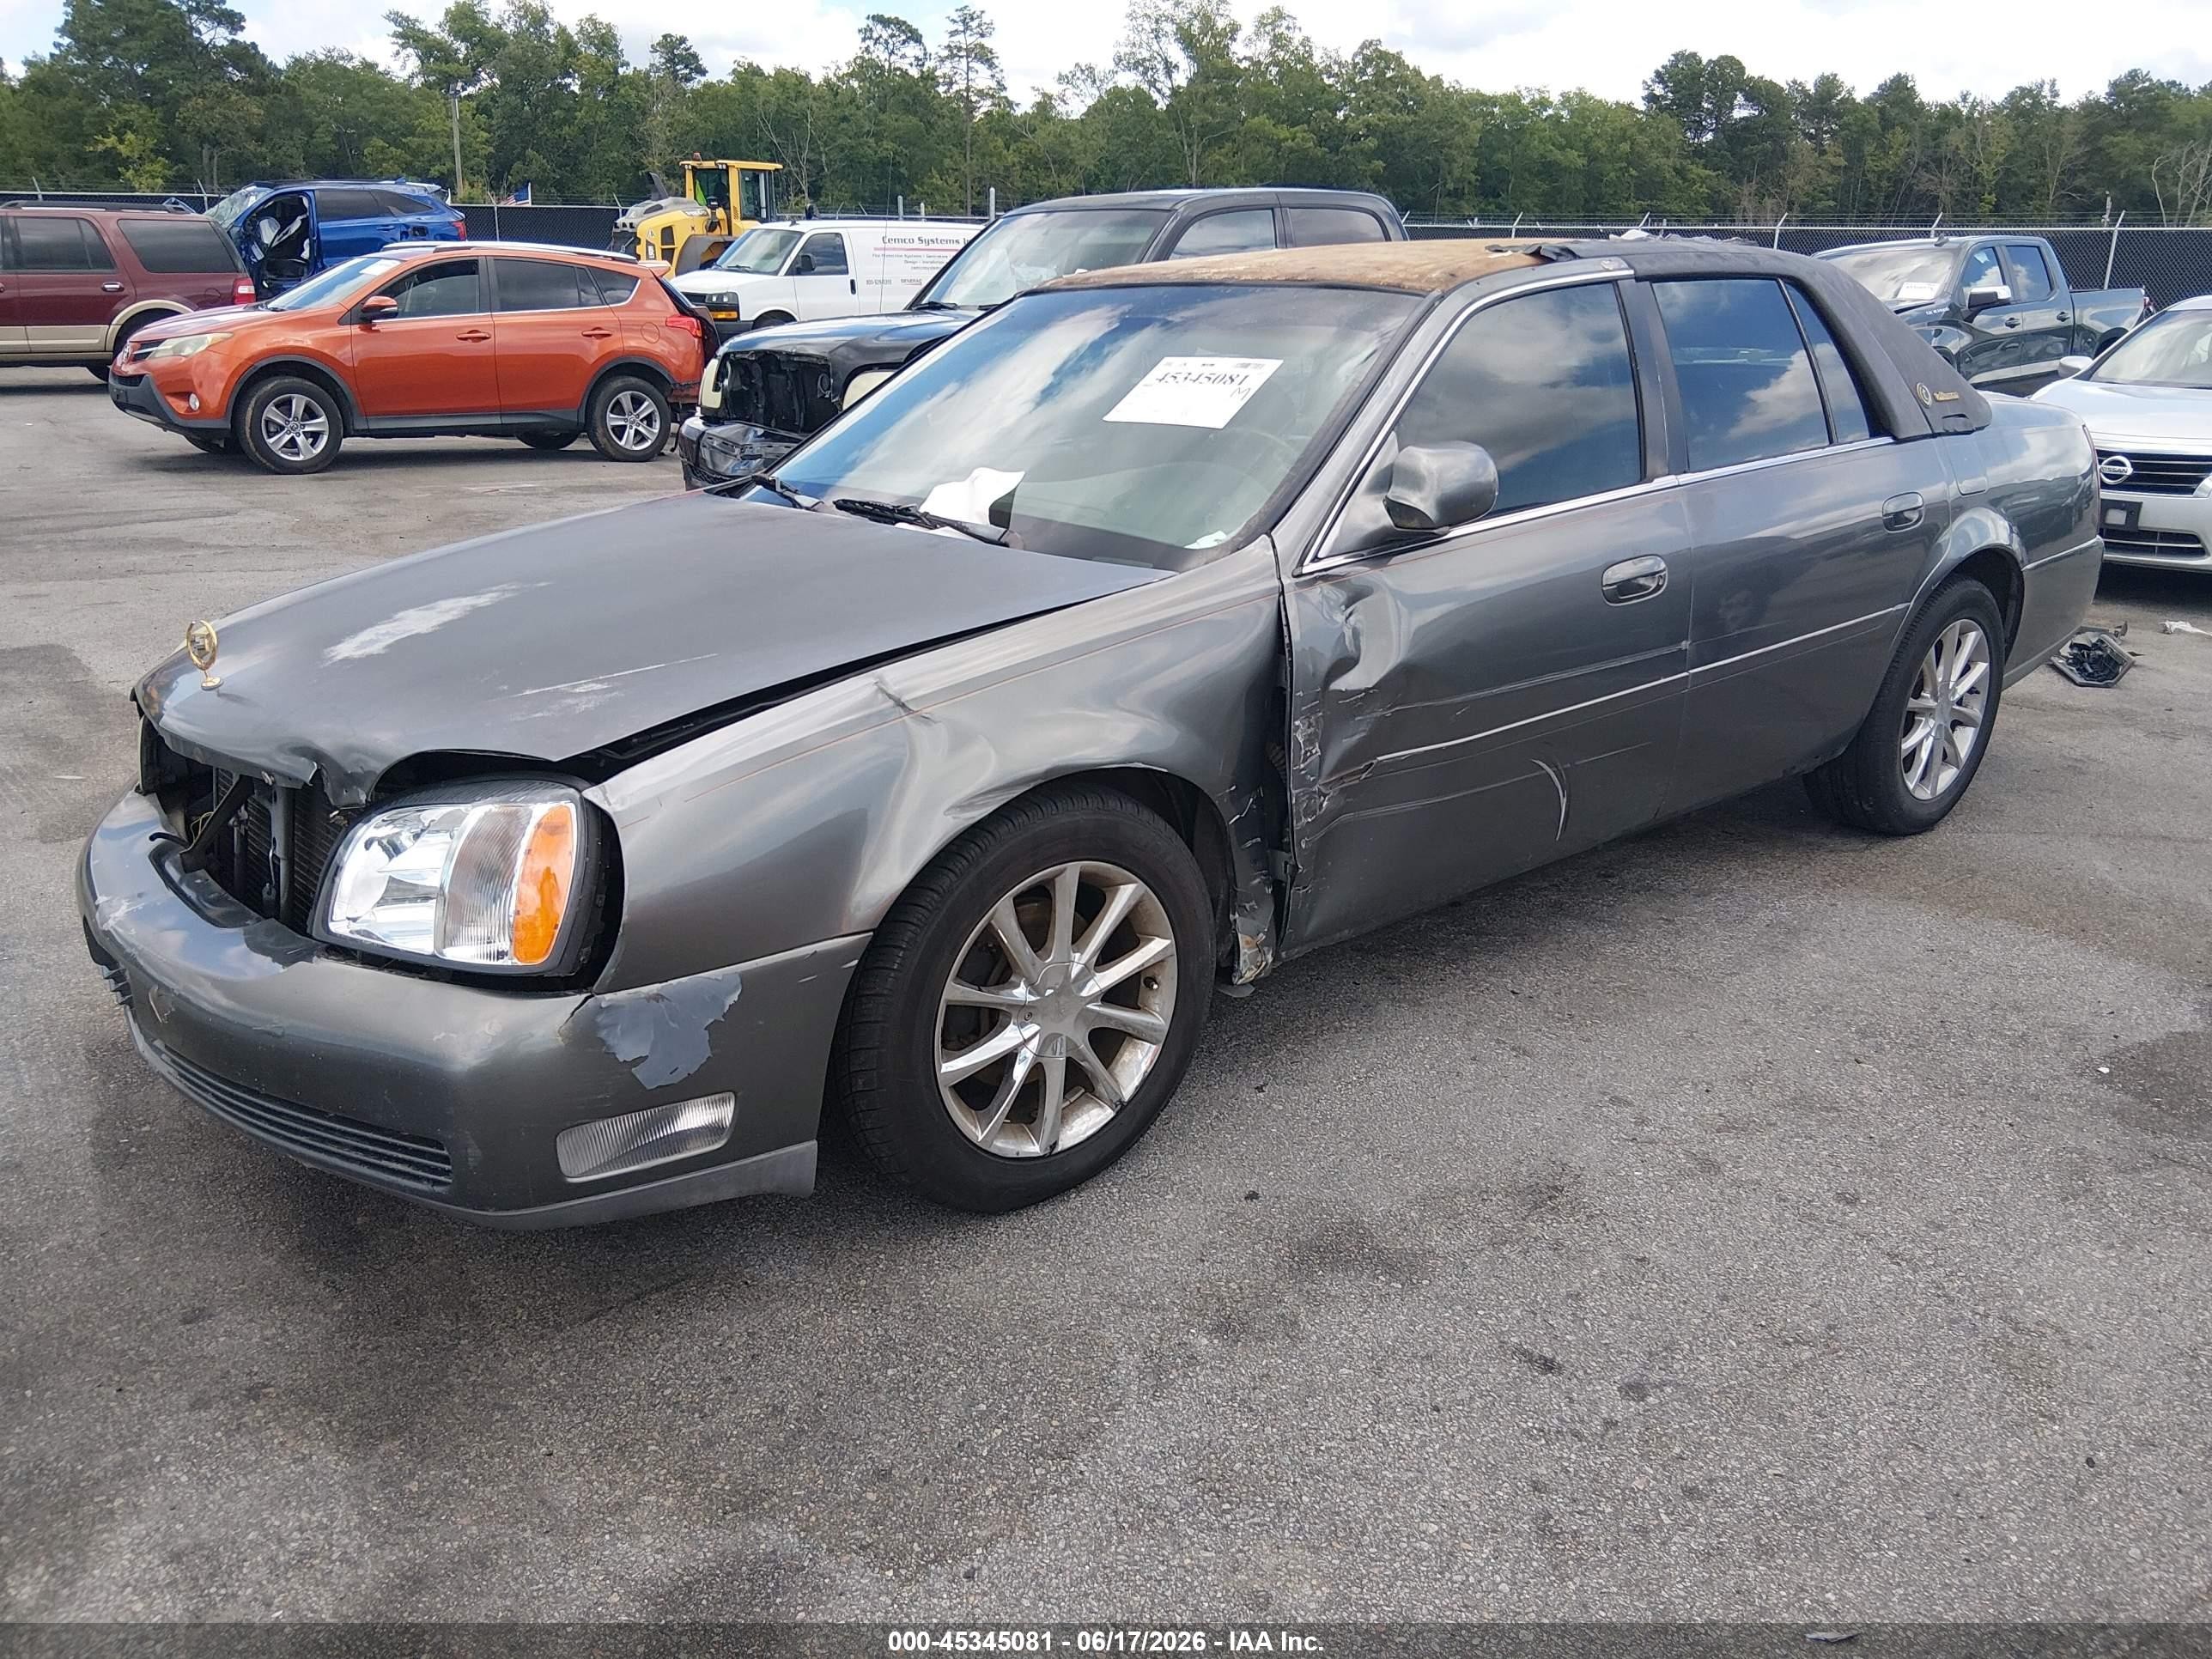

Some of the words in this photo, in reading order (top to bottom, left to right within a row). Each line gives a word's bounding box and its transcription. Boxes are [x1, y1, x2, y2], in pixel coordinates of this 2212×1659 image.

[882, 236, 915, 245] Cemco
[917, 236, 960, 246] Systems
[1156, 372, 1249, 386] 45345081
